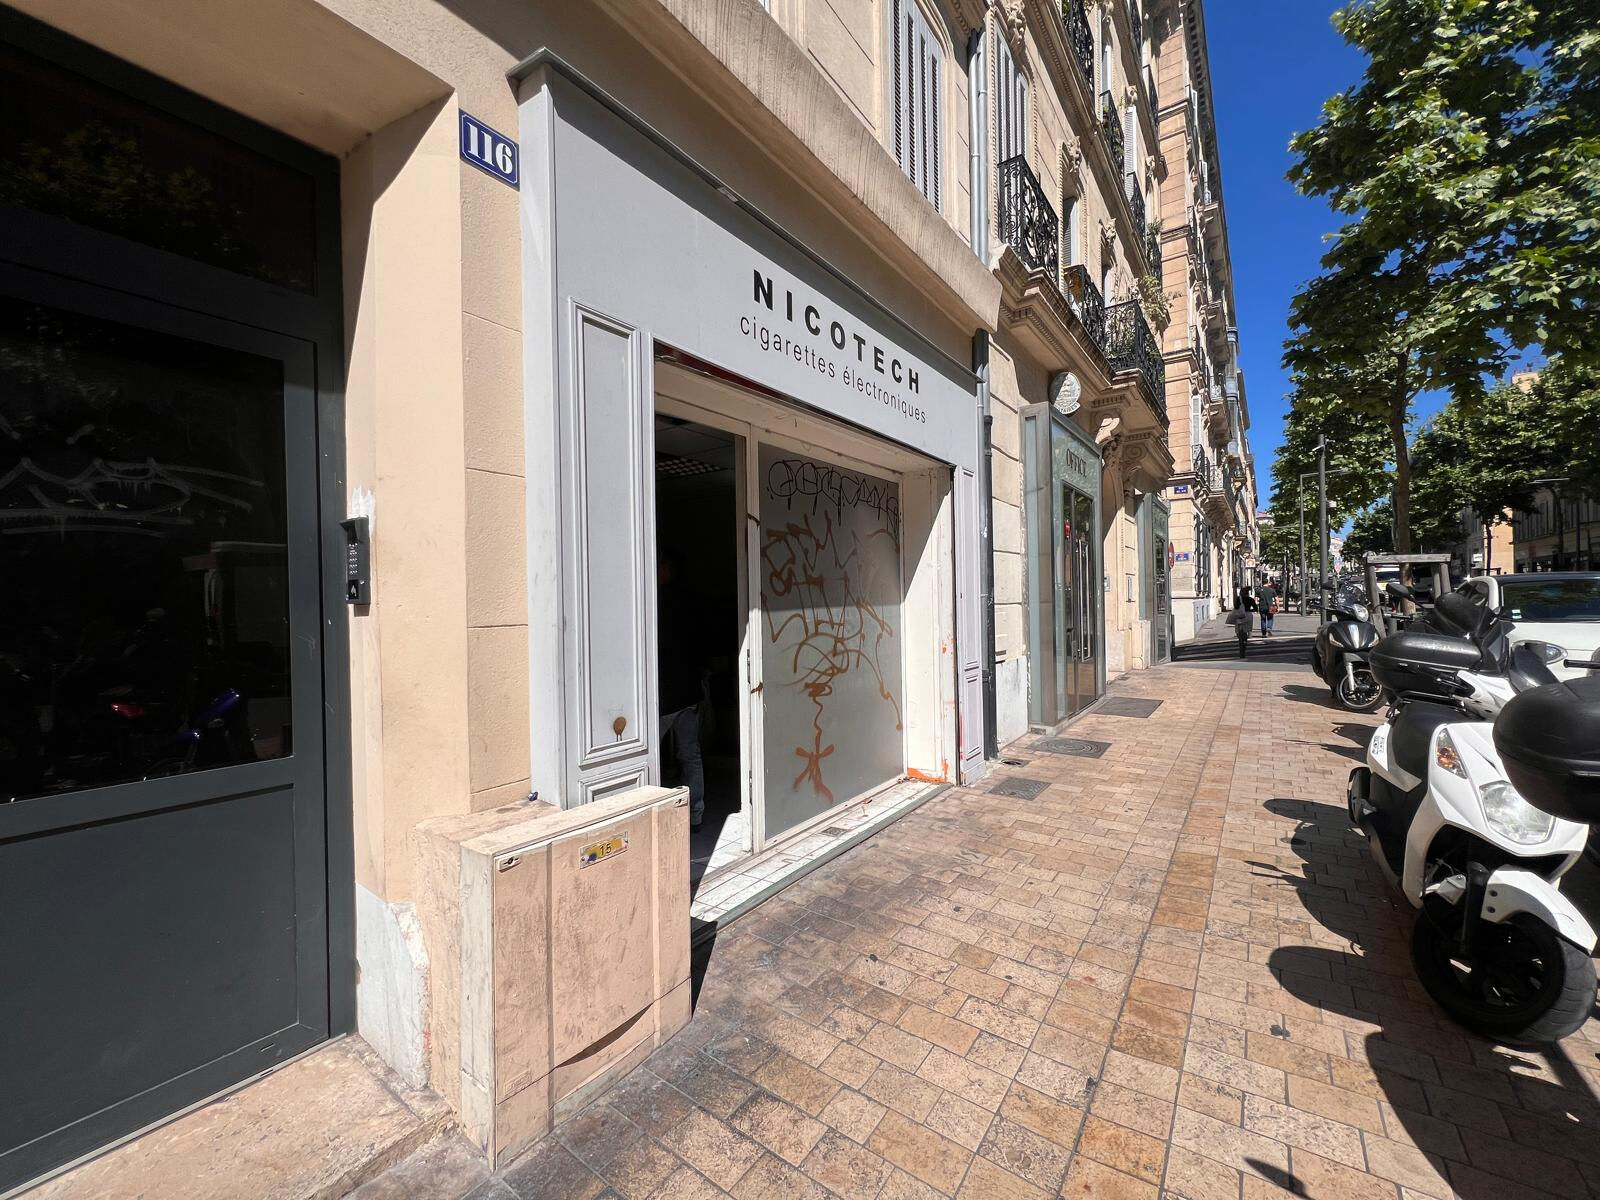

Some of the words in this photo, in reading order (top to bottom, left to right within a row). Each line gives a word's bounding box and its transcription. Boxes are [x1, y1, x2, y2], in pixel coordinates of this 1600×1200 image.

[466, 122, 513, 175] 116
[740, 315, 835, 379] cigarettes
[843, 366, 926, 424] électroniques
[753, 269, 919, 394] NICOTECH
[600, 843, 612, 856] 15
